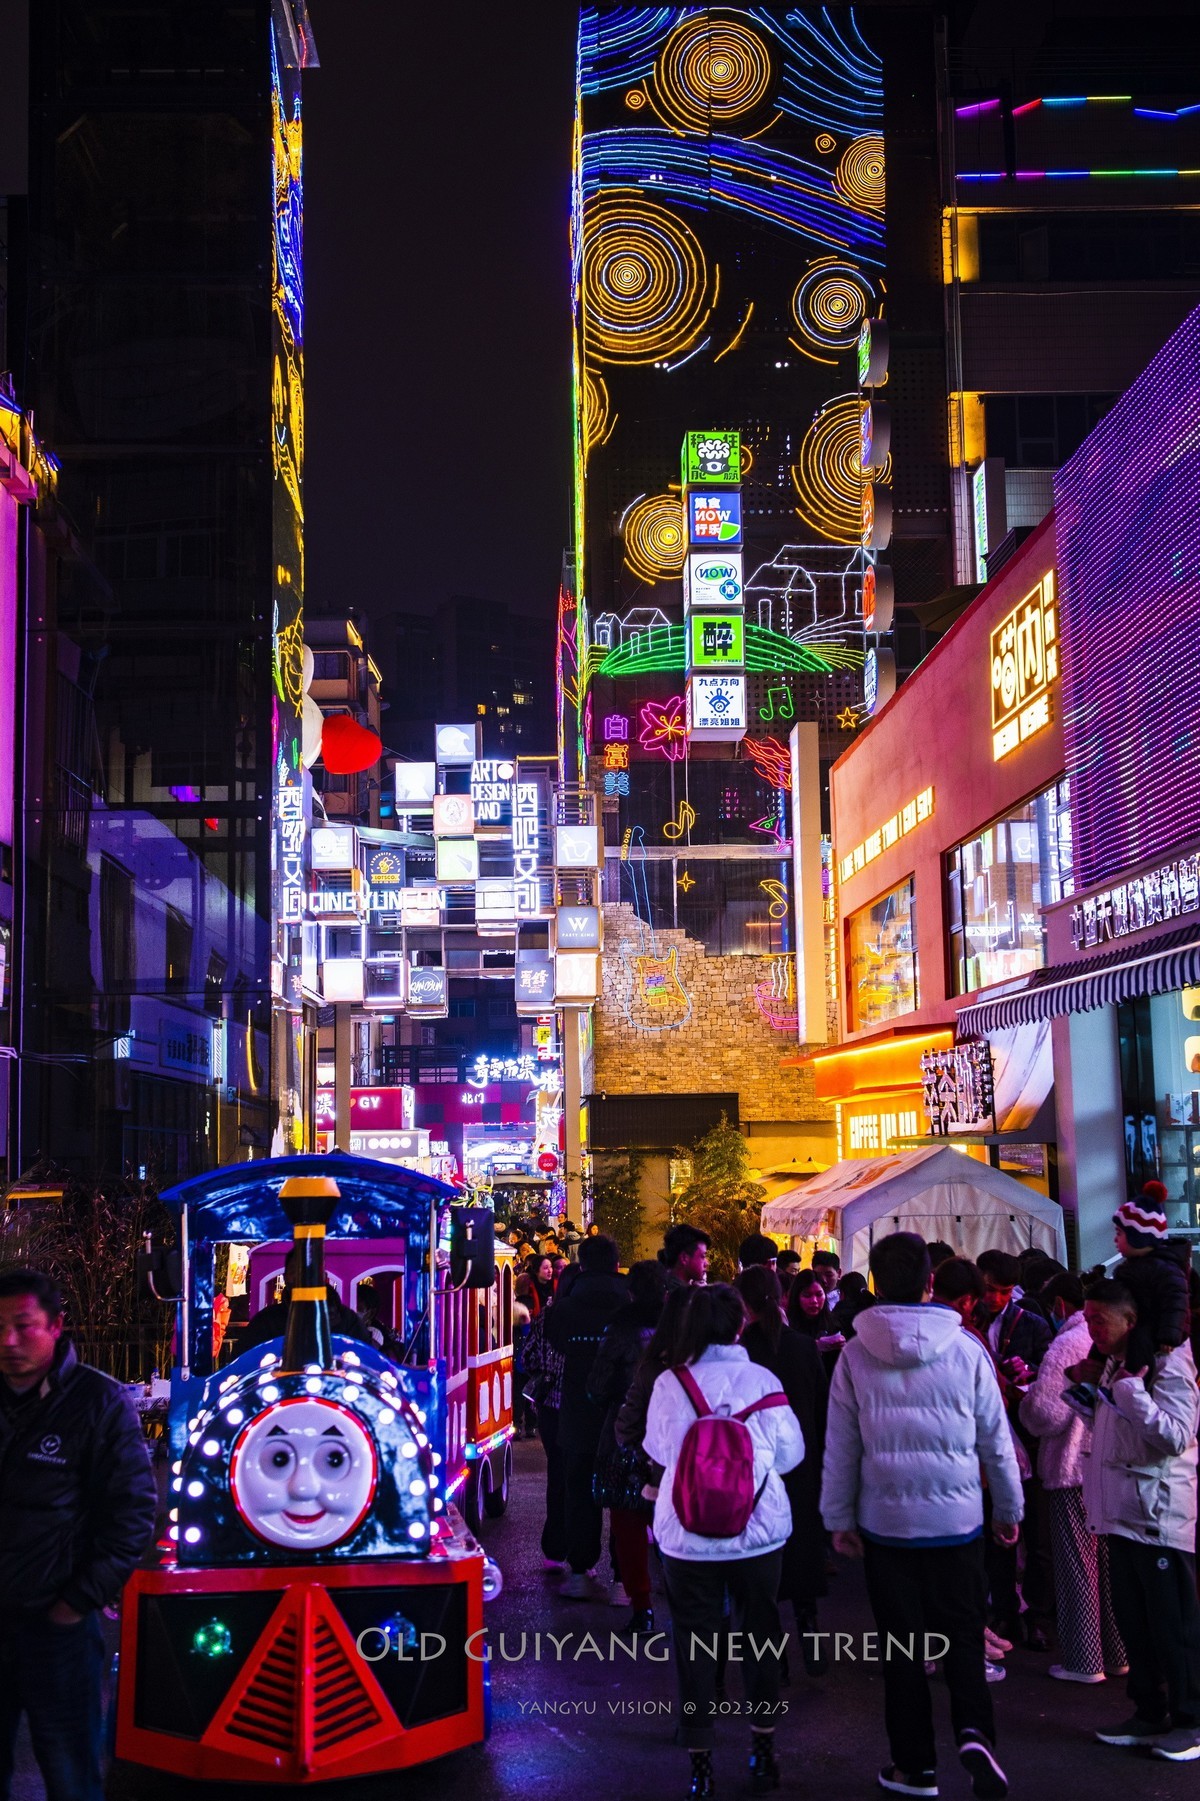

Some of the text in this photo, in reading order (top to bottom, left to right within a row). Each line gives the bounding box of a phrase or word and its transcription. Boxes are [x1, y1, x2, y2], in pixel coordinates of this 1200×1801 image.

[698, 678, 740, 687] 九点方向
[699, 717, 740, 726] 漂亮姐姐
[470, 783, 511, 801] DESIGN
[471, 802, 501, 820] LAND
[512, 783, 540, 916] 酒吧文创
[358, 1096, 381, 1109] GY
[461, 1092, 485, 1105] 北门
